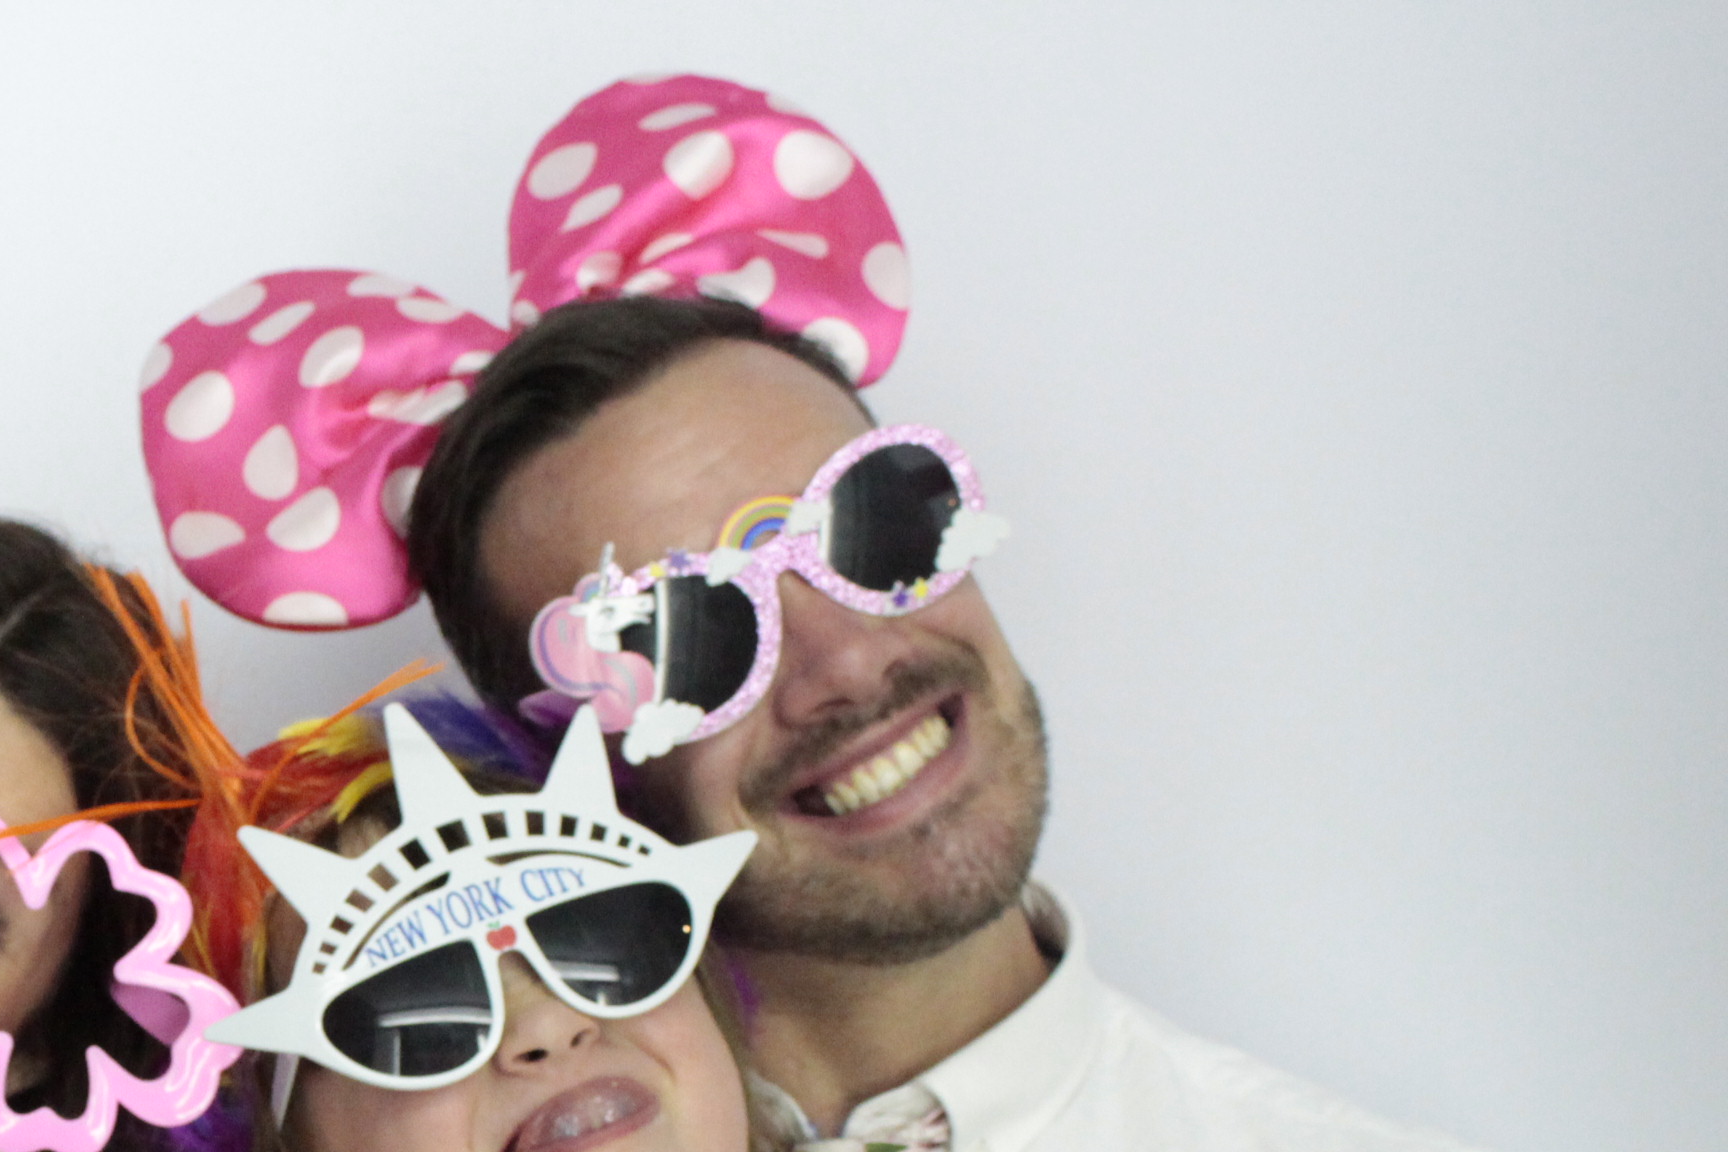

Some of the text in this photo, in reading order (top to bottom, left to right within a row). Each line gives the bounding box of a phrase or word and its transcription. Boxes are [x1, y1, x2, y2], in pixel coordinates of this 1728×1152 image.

[365, 868, 586, 967] NEW YORK CITY
